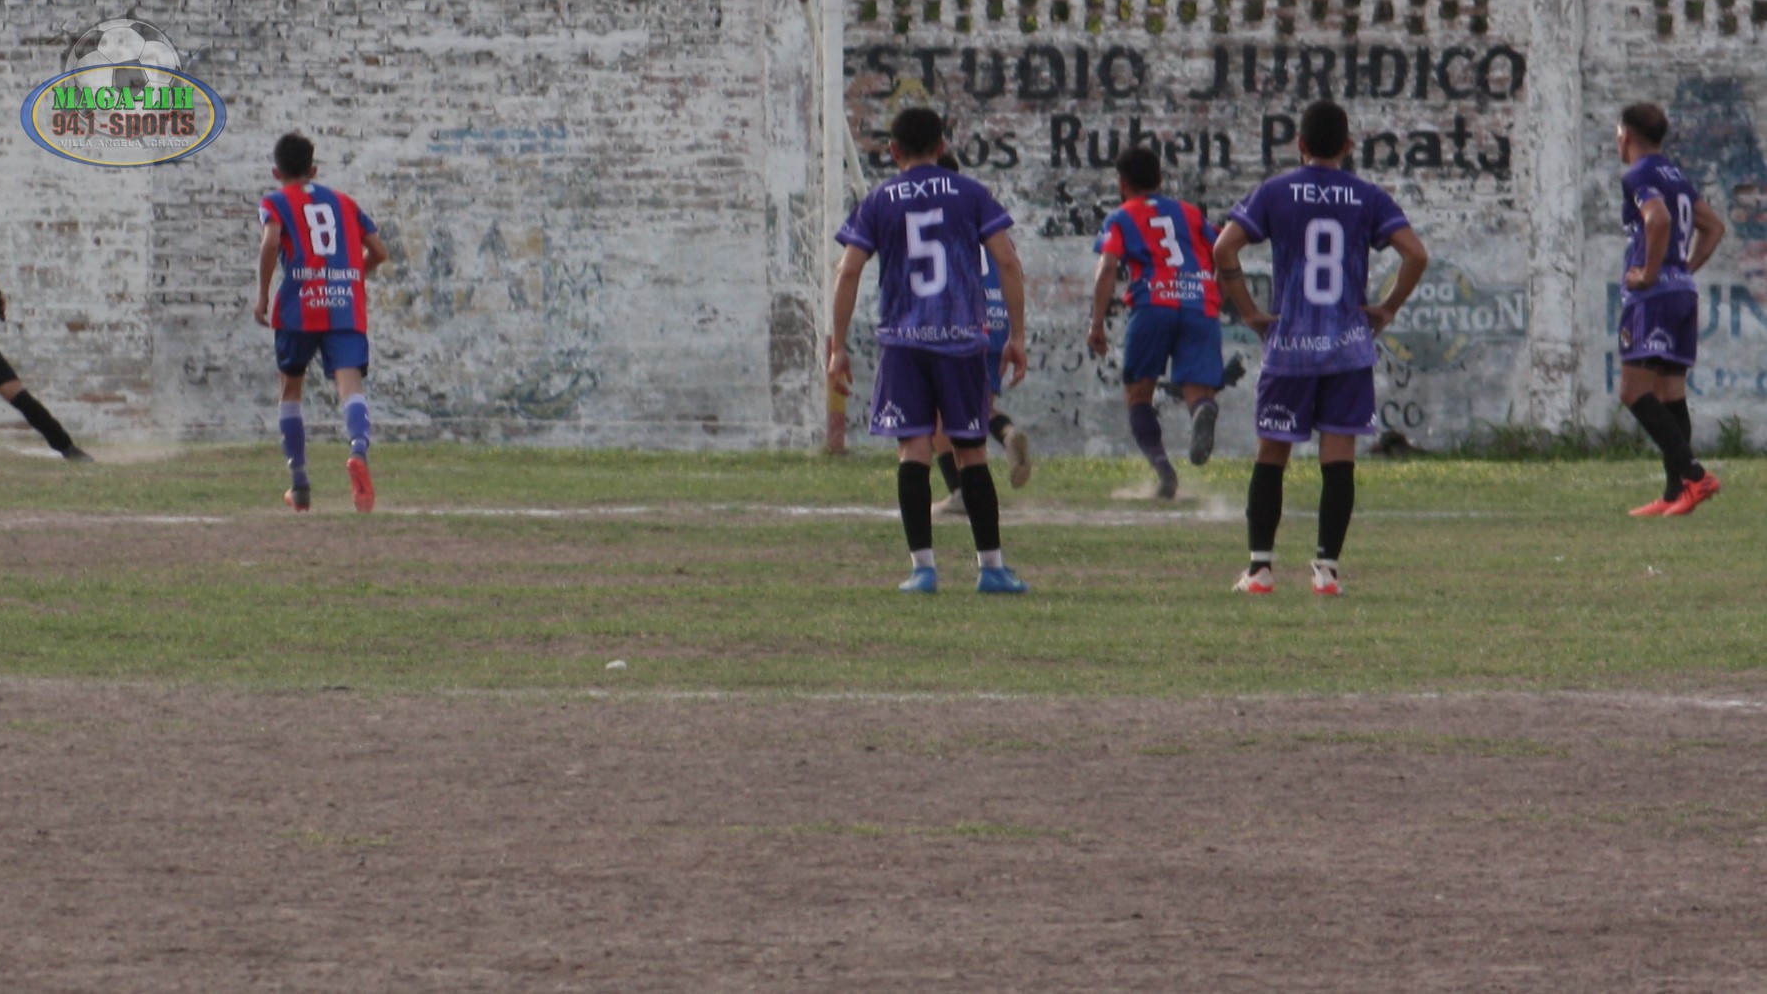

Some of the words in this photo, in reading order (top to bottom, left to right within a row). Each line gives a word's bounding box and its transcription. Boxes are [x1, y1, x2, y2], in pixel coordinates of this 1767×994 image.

[1188, 44, 1526, 101] JURIDICO
[1261, 112, 1513, 176] Pnata
[885, 177, 959, 202] TEXTIL
[1289, 183, 1362, 205] TEXTIL
[303, 203, 337, 255] 8
[905, 208, 948, 297] 5
[1149, 216, 1185, 267] 3
[1677, 193, 1693, 262] 9
[1303, 218, 1345, 305] 8
[299, 286, 314, 298] LA
[316, 286, 354, 298] TIGRA
